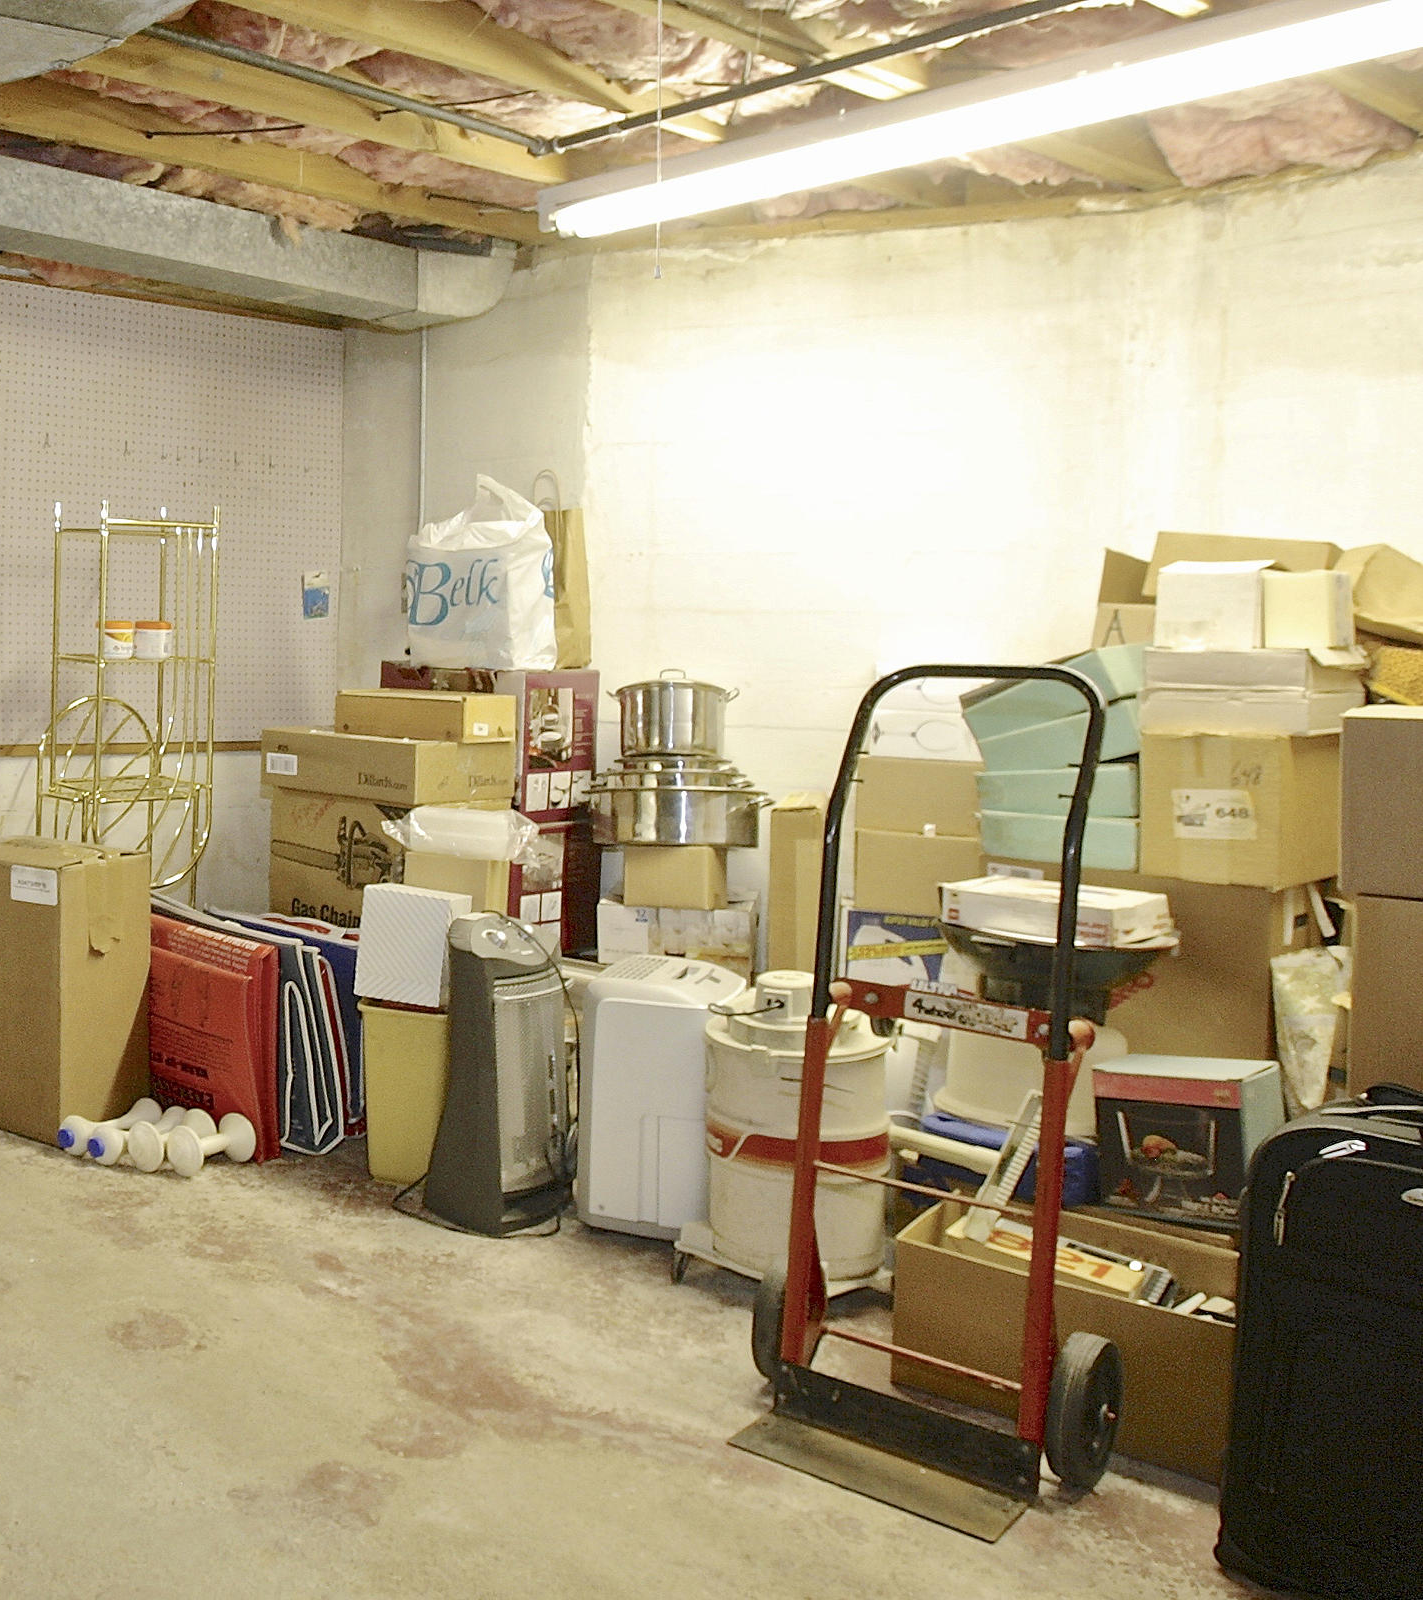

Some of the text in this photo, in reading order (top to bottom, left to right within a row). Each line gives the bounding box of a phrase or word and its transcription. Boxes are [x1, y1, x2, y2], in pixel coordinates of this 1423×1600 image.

[406, 558, 499, 626] Belk
[1215, 808, 1249, 819] 648
[291, 897, 316, 918] Gas
